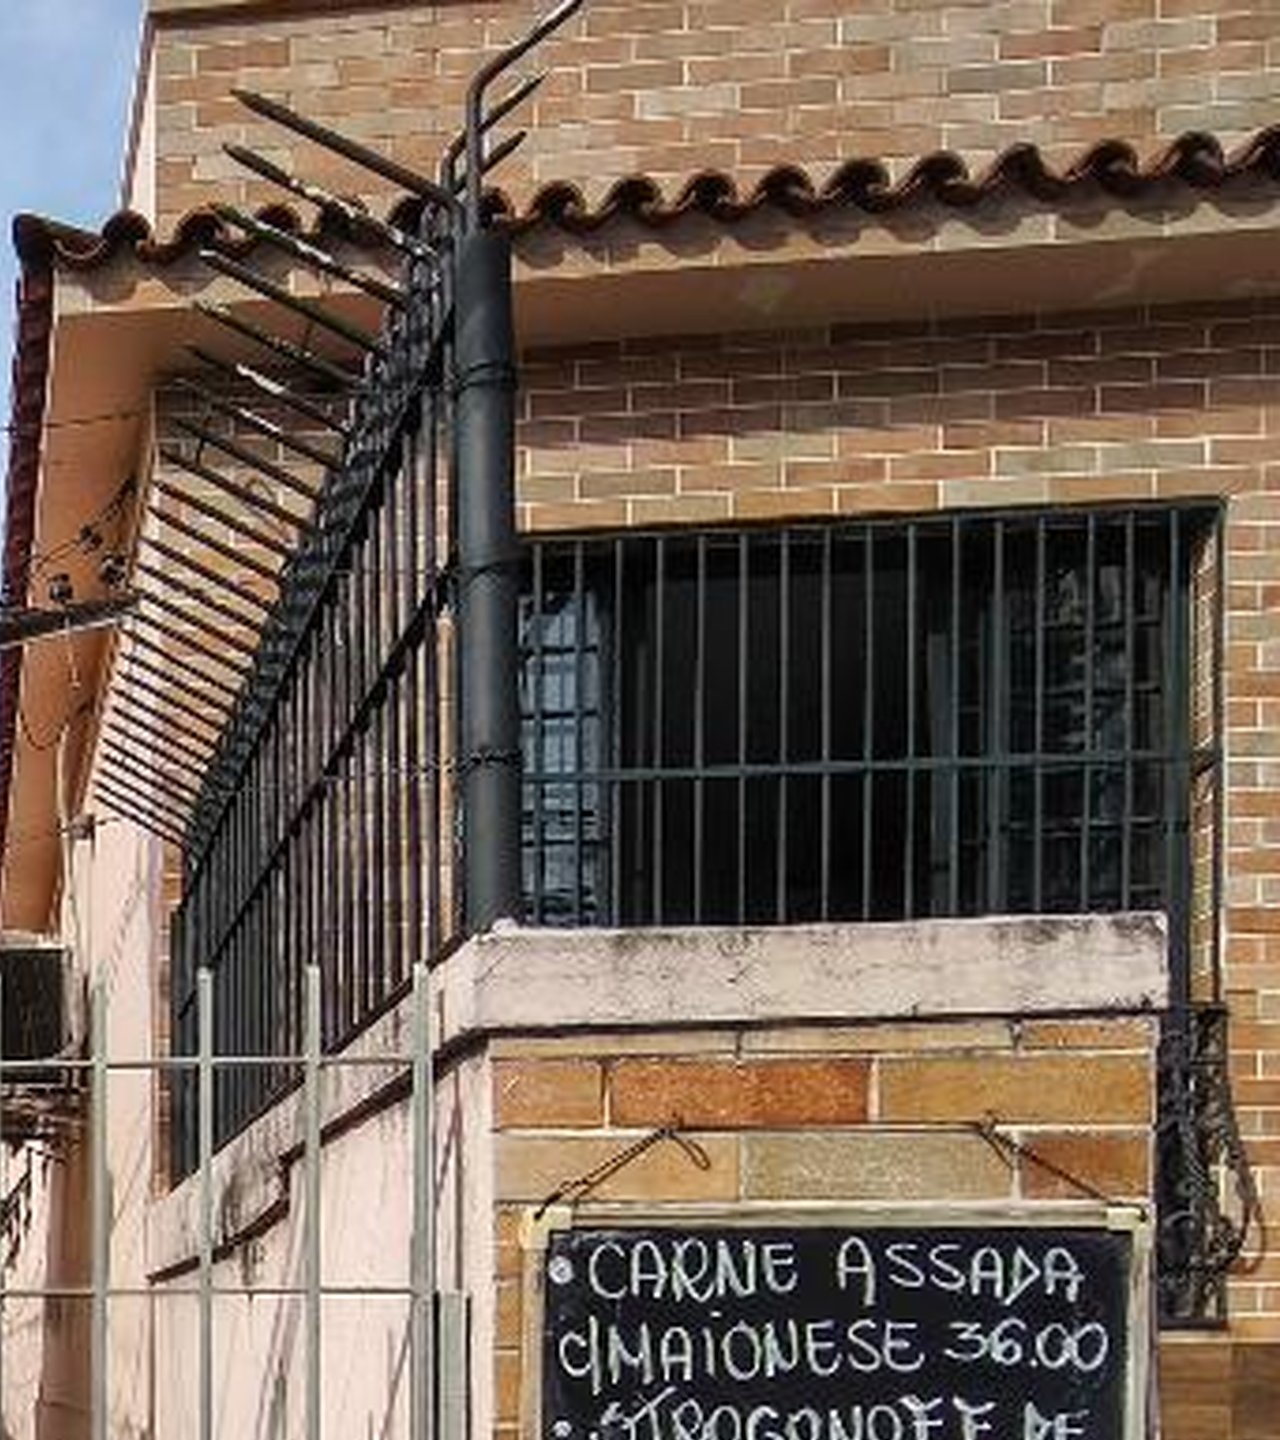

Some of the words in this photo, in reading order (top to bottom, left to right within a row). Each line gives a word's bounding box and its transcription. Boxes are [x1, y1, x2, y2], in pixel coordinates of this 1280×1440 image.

[587, 1240, 798, 1303] CARNE
[836, 1236, 1086, 1306] ASSADA
[944, 1319, 1108, 1371] 36.00
